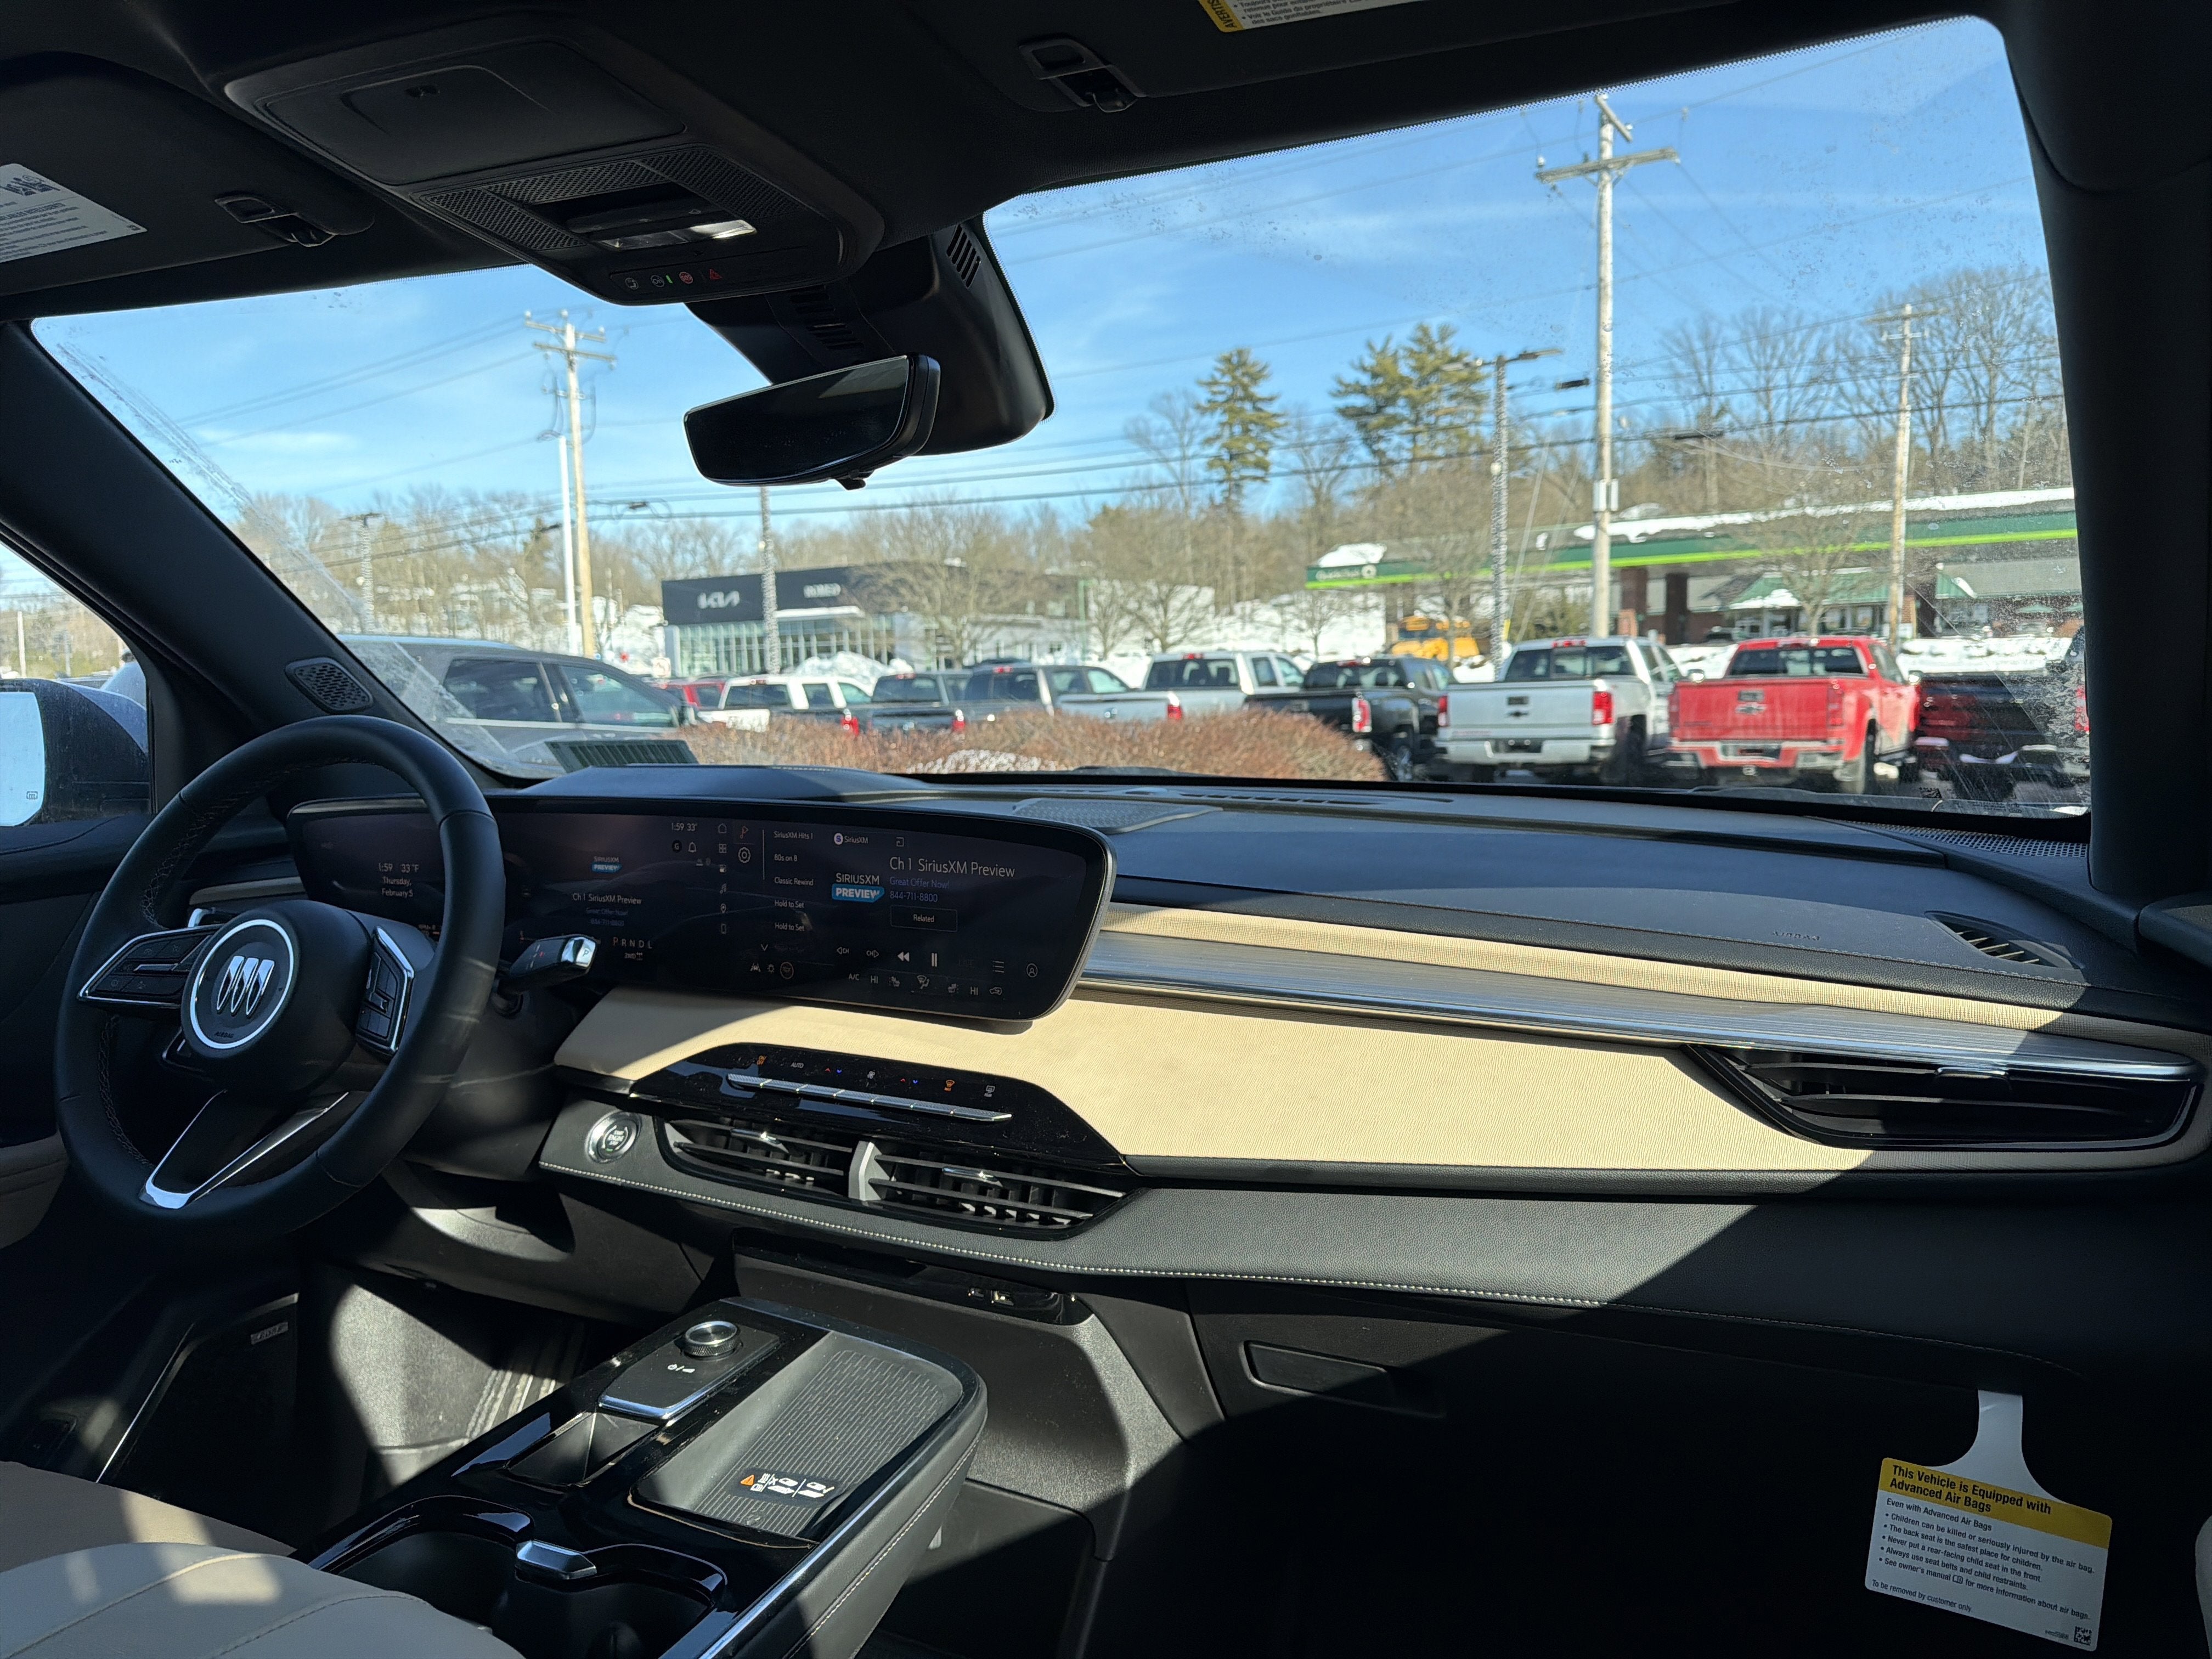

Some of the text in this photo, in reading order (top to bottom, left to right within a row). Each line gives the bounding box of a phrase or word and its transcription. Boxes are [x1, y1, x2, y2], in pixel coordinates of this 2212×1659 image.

[672, 822, 684, 831] 1:59
[774, 830, 797, 839] SiriusXM
[379, 862, 393, 872] 1:59
[890, 857, 905, 870] Ch
[918, 858, 967, 874] SiriusXM
[971, 861, 1015, 878] Preview
[794, 878, 814, 886] Rewind
[836, 873, 879, 885] SIRIUSXM
[890, 877, 909, 887] Great
[911, 877, 929, 888] Offer
[382, 888, 408, 898] February
[588, 894, 615, 902] SiriusXM
[617, 895, 642, 904] Preview
[836, 887, 880, 899] PREVIEW
[890, 890, 938, 902] 844-711-8800
[913, 913, 935, 923] Related
[1773, 932, 1820, 940] AIRBAG
[613, 937, 618, 946] P
[639, 940, 645, 949] D
[648, 940, 652, 949] L
[849, 973, 859, 981] A/C
[871, 975, 878, 984] HI
[970, 986, 979, 995] HI
[1889, 1477, 1991, 1513] Advanced Air Bags
[1892, 1464, 1914, 1479] This
[1917, 1470, 1956, 1489] Vehicle
[1972, 1485, 2023, 1506] Equipped
[2026, 1500, 2051, 1514] with
[1887, 1497, 1991, 1531] Even with Advanced Air Bags
[1889, 1523, 1901, 1533] The
[1903, 1527, 1919, 1538] back
[1921, 1533, 1935, 1542] seat
[1944, 1538, 1955, 1547] the
[1957, 1543, 1978, 1553] safest
[1979, 1548, 1998, 1558] place
[2000, 1553, 2010, 1561] for
[1891, 1513, 1919, 1526] Children
[1946, 1527, 1966, 1538] killed
[1978, 1536, 2010, 1551] seriously
[2012, 1544, 2039, 1558] injured
[2052, 1556, 2063, 1565] the
[1887, 1535, 1907, 1545] Never
[1927, 1547, 1965, 1562] rear-facing
[1966, 1556, 1983, 1566] child
[1984, 1561, 2000, 1571] seat
[2010, 1567, 2021, 1577] the
[1886, 1547, 1909, 1558] Always
[1925, 1558, 1939, 1566] seat
[1941, 1560, 1957, 1571] belts
[1974, 1570, 1991, 1580] child
[1884, 1558, 1897, 1566] See
[1898, 1562, 1925, 1573] owner's
[1926, 1569, 1951, 1581] manual
[1965, 1578, 1974, 1587] for
[1976, 1583, 1994, 1592] more
[1995, 1587, 2035, 1604] information
[2037, 1600, 2057, 1611] about
[1889, 1585, 1917, 1597] removed
[1927, 1595, 1957, 1607] customer
